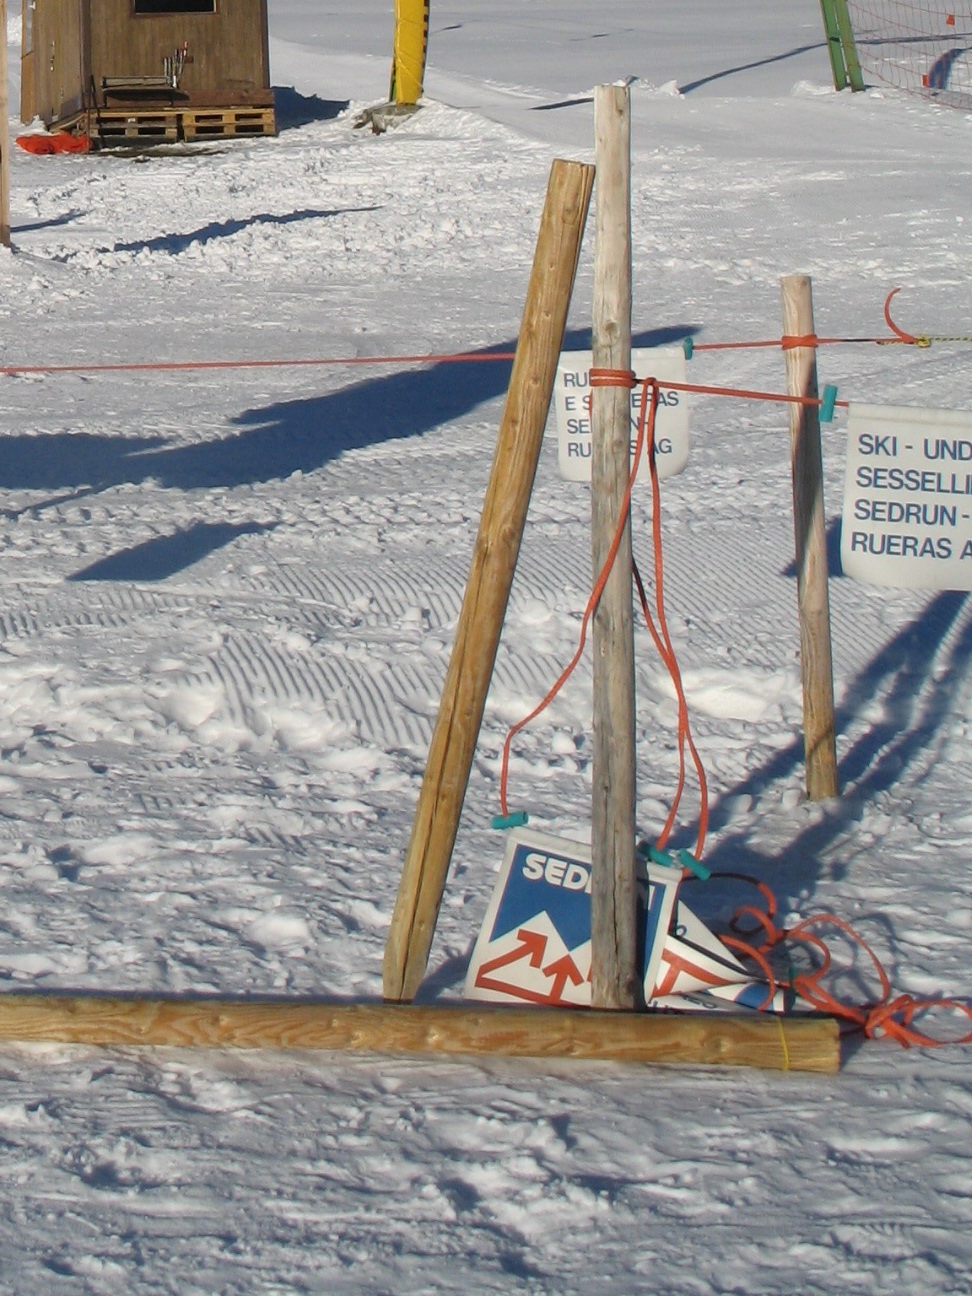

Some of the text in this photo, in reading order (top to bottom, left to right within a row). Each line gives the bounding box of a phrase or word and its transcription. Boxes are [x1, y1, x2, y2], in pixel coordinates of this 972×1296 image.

[858, 433, 897, 457] SKI
[924, 438, 972, 461] UND
[855, 466, 972, 495] SESSELLI
[853, 499, 957, 526] SEDRUN
[851, 531, 952, 560] RUERAS
